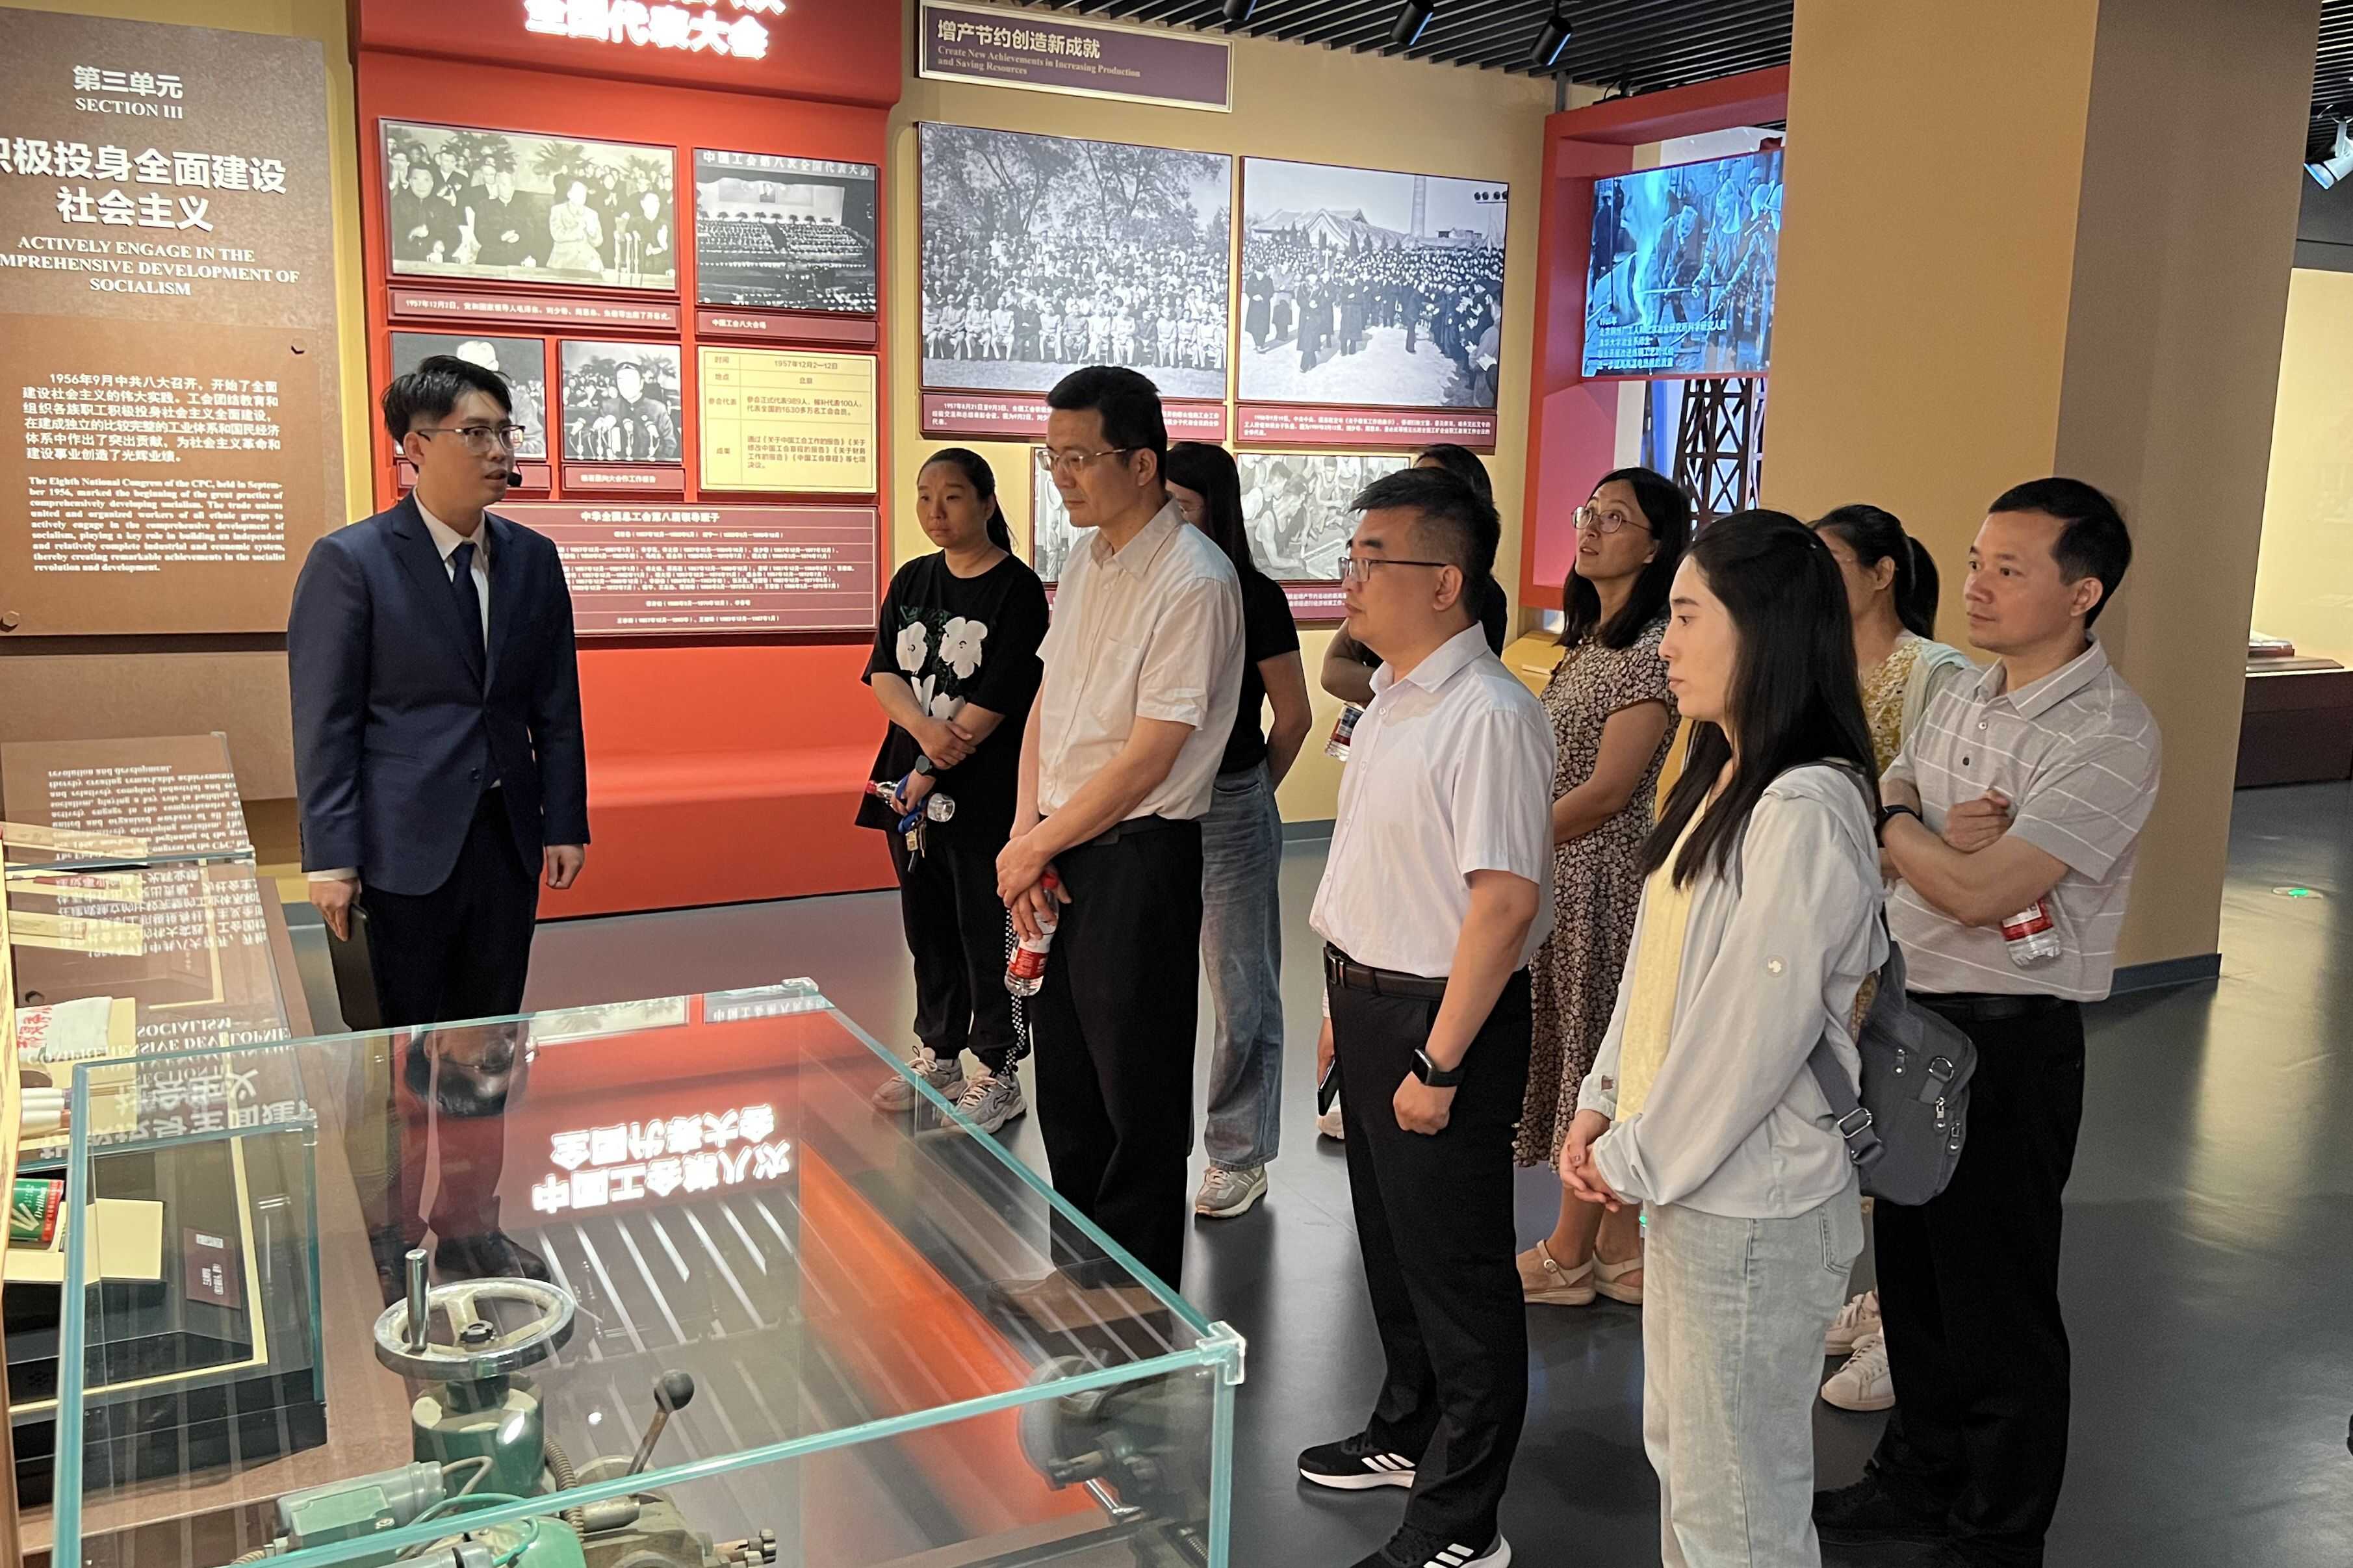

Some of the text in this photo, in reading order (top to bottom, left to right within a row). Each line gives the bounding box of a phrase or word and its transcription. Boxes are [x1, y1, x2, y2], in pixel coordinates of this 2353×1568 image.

[938, 19, 1100, 58] 增产节约创造新成就
[938, 45, 1140, 77] Create New Achievements in Increasing Production
[956, 58, 984, 71] Saving
[986, 62, 1027, 74] Resources
[73, 66, 183, 99] 第三单元
[75, 97, 182, 118] SECTION III
[57, 186, 214, 232] 社会主义
[18, 237, 255, 262] ACTIVELY ENGAGE IN THE
[138, 262, 272, 281] DEVELOPMENT
[276, 270, 300, 283] OF
[90, 278, 190, 295] SOCIALISM
[50, 374, 277, 392] 1956年9月中共八大召开，开始了全面
